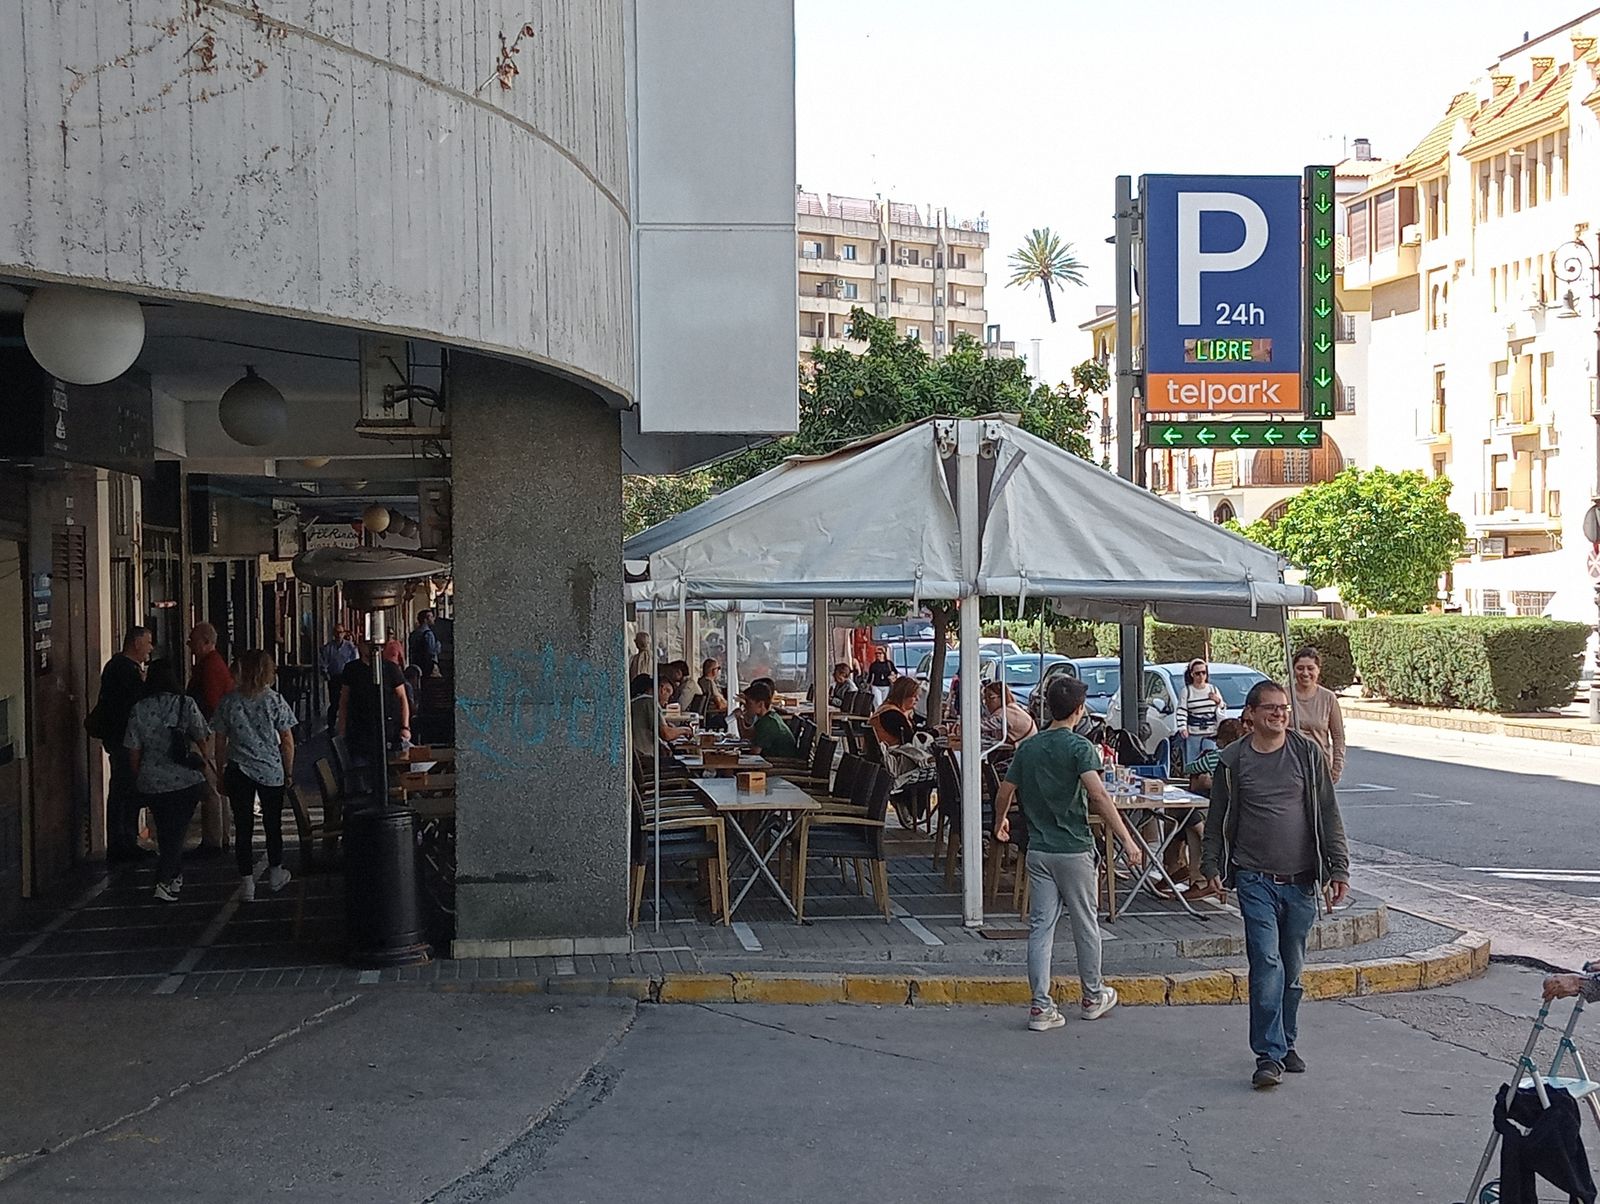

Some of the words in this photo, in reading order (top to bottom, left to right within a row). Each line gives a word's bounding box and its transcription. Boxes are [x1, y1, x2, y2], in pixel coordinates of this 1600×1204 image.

[1178, 192, 1269, 326] P
[1215, 303, 1265, 325] 24h
[1196, 340, 1253, 360] LIBRE
[1167, 379, 1281, 410] telpark
